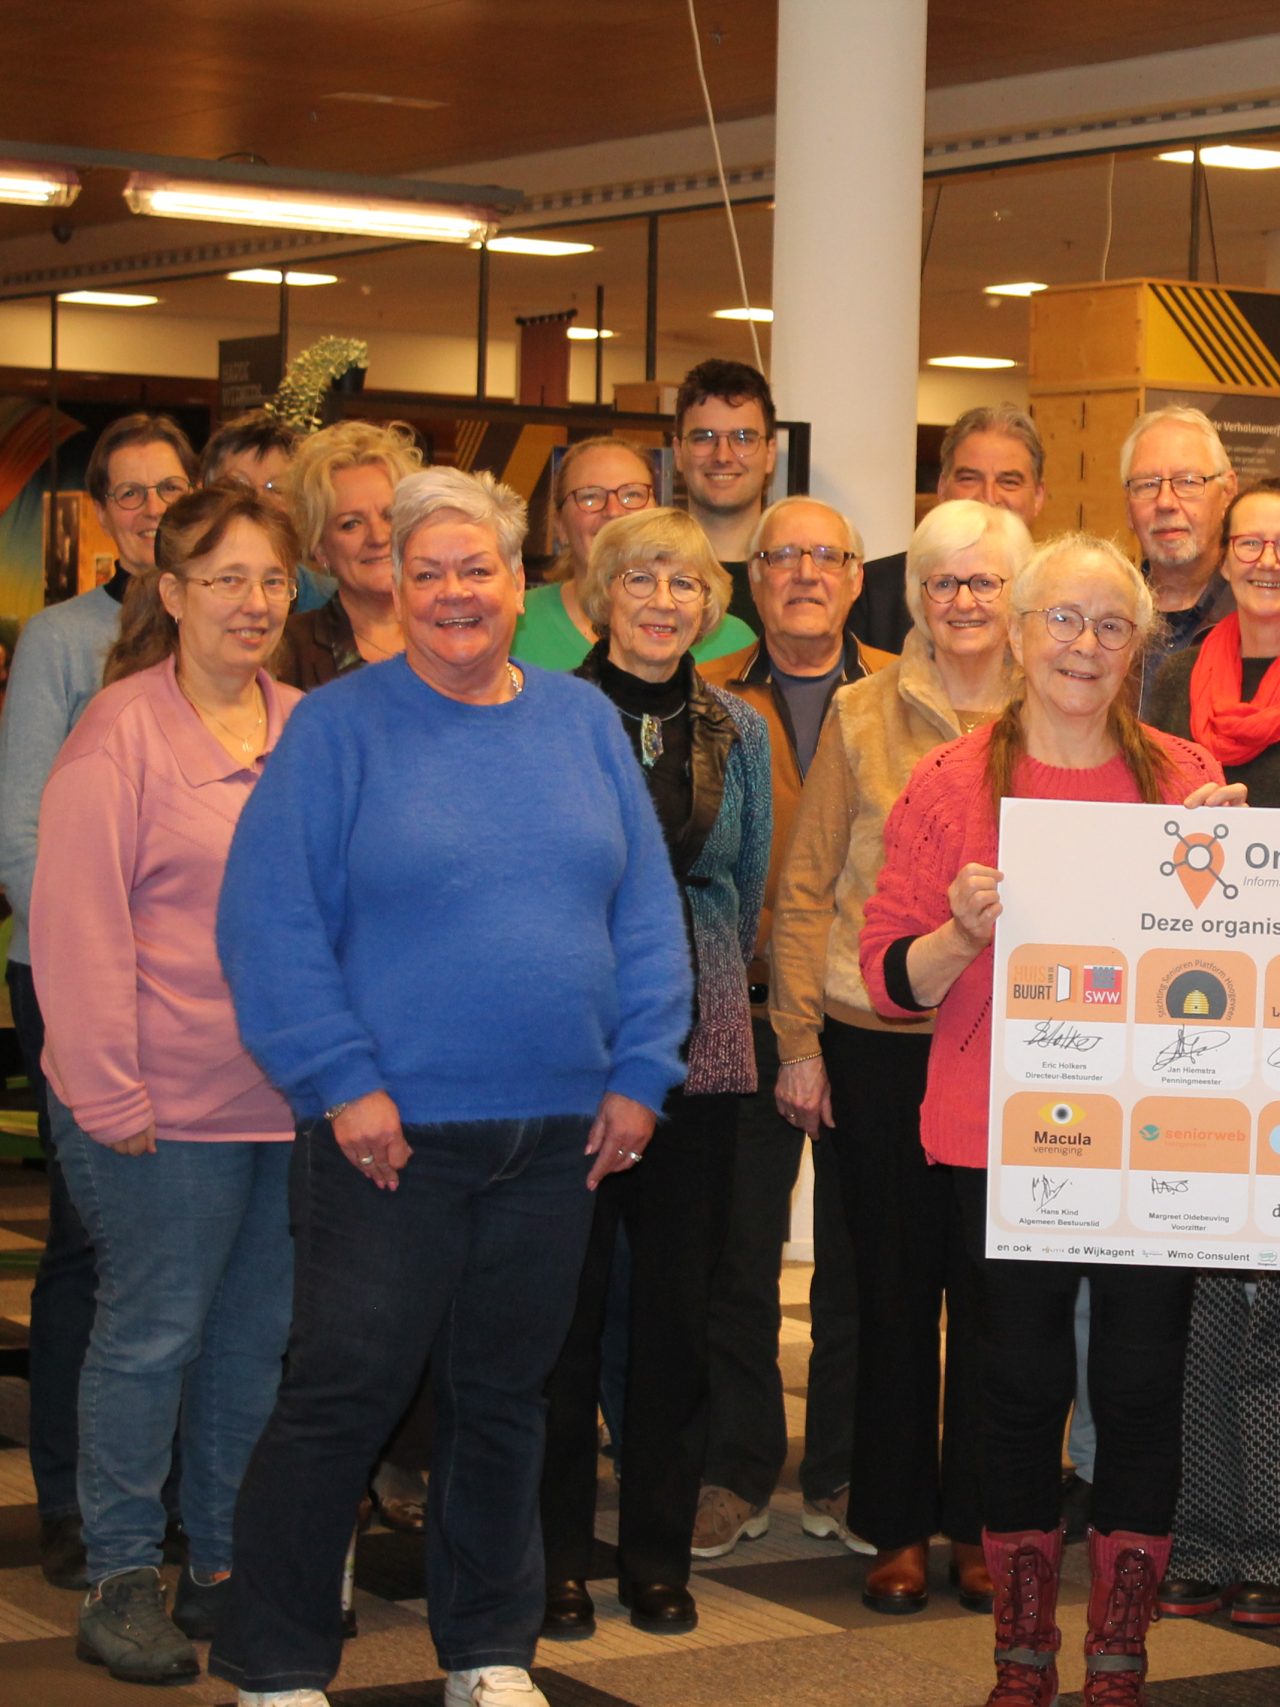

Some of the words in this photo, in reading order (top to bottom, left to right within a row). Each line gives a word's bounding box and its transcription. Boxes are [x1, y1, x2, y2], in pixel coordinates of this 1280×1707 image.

[1224, 421, 1280, 437] Verhalenwerf
[1141, 913, 1194, 932] Deze
[1195, 959, 1227, 978] Platform
[1013, 984, 1053, 1000] BUURT
[1085, 990, 1120, 1003] SWW
[1042, 1061, 1057, 1070] Eric
[1058, 1062, 1087, 1070] Holkers
[1167, 1066, 1184, 1074] Jan
[1186, 1066, 1216, 1075] Hiemstra
[1025, 1072, 1103, 1081] Directeur-Bestuurder
[1161, 1077, 1221, 1086] Penningmeester
[1034, 1130, 1092, 1146] Macula
[1165, 1128, 1246, 1142] seniorweb
[1033, 1145, 1083, 1156] vereniging
[1041, 1208, 1059, 1216] Hans
[1061, 1209, 1079, 1217] Kind
[1148, 1212, 1181, 1222] Margreet
[1019, 1217, 1056, 1226] Algemeen
[1057, 1219, 1100, 1228] Bestuurslid
[1171, 1224, 1207, 1232] Voorzitter
[997, 1244, 1010, 1252] en
[1012, 1243, 1032, 1252] ook
[1068, 1245, 1081, 1254] de
[1083, 1246, 1135, 1259] Wijkagent
[1167, 1250, 1194, 1259] Wmo
[1197, 1250, 1250, 1262] Consulent
